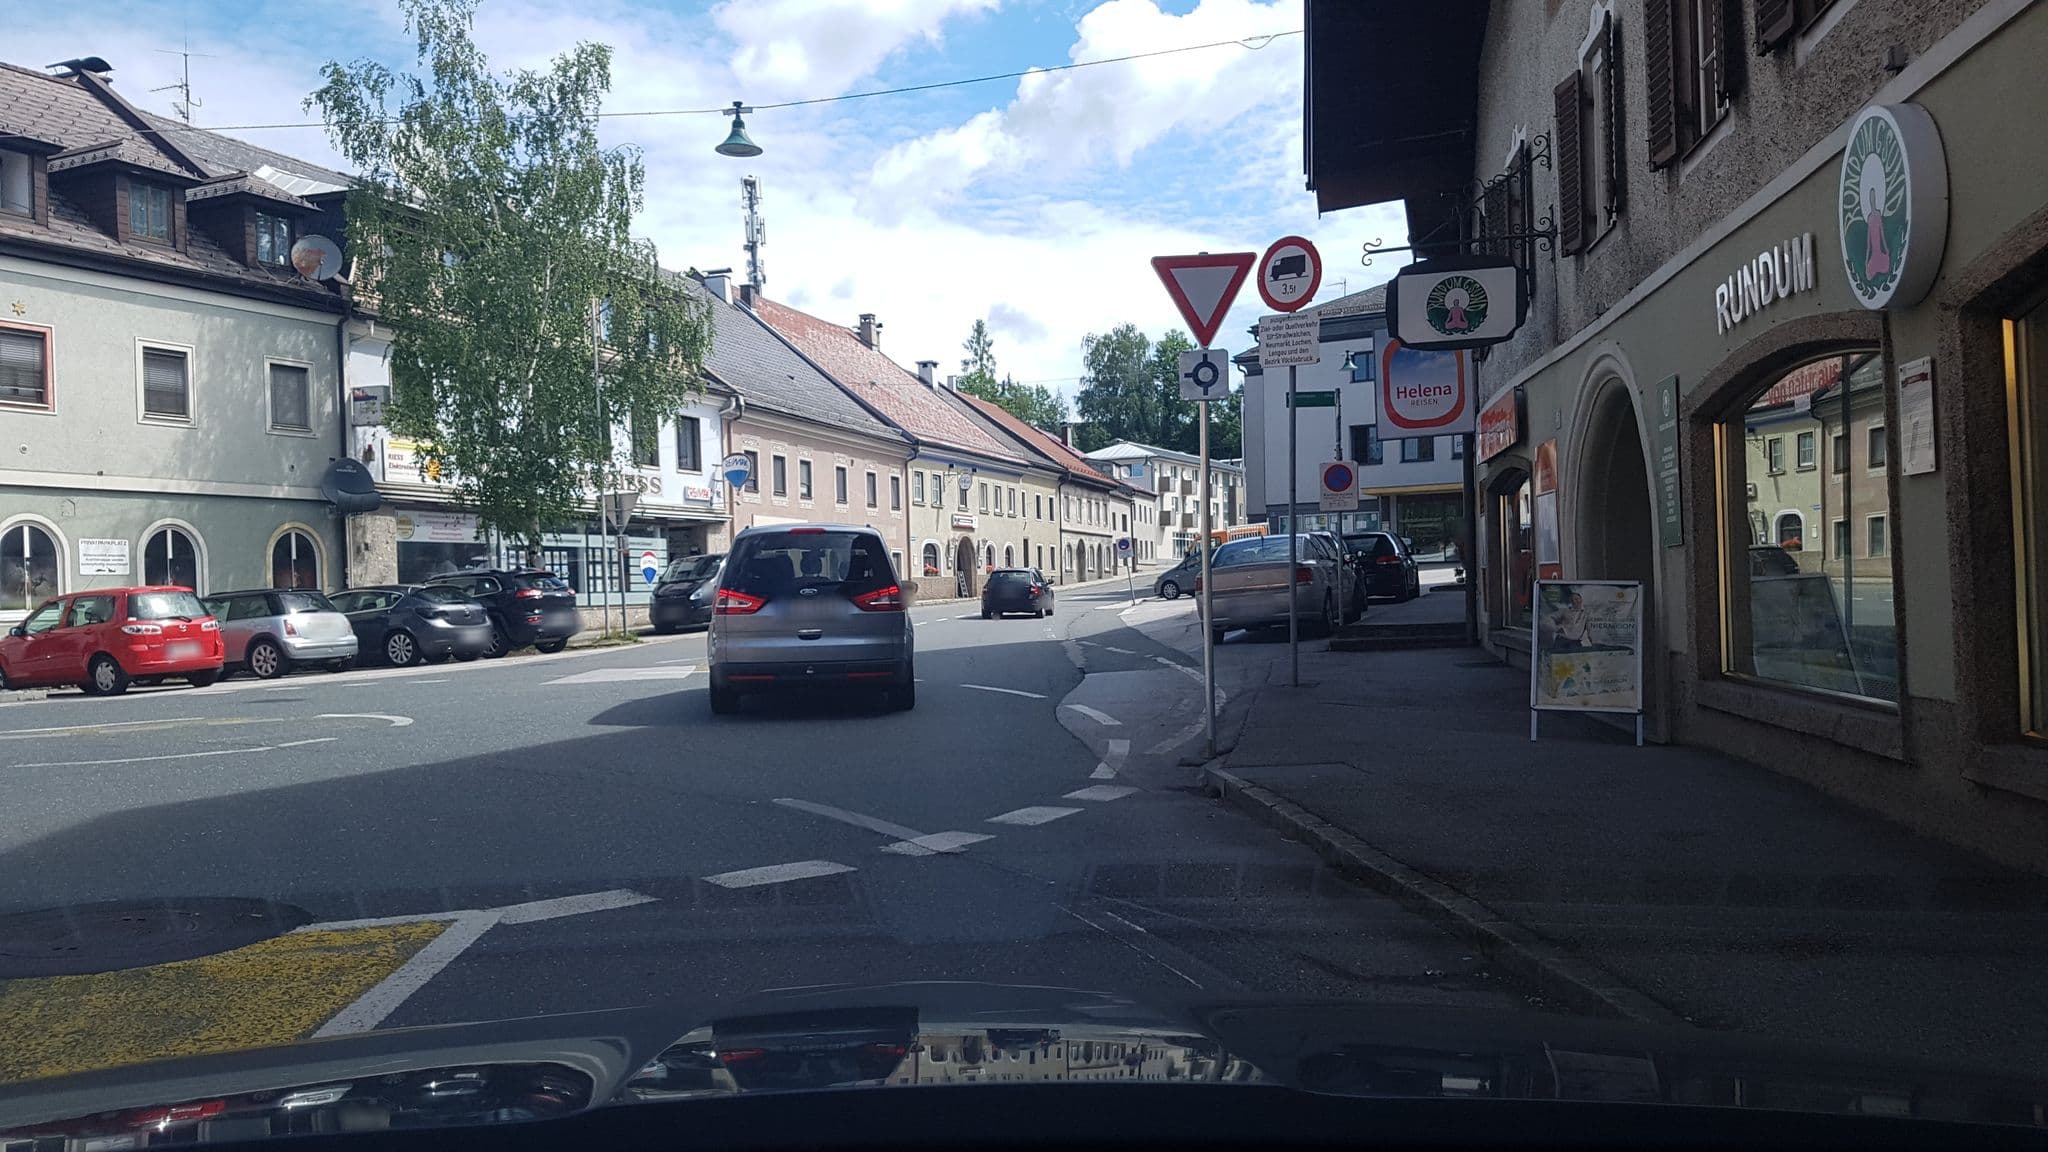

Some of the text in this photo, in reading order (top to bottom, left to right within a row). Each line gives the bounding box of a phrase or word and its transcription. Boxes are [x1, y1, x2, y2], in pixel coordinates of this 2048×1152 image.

[1715, 231, 1812, 335] RUNDUM
[1396, 384, 1452, 400] Helena
[1410, 399, 1438, 407] REISEN
